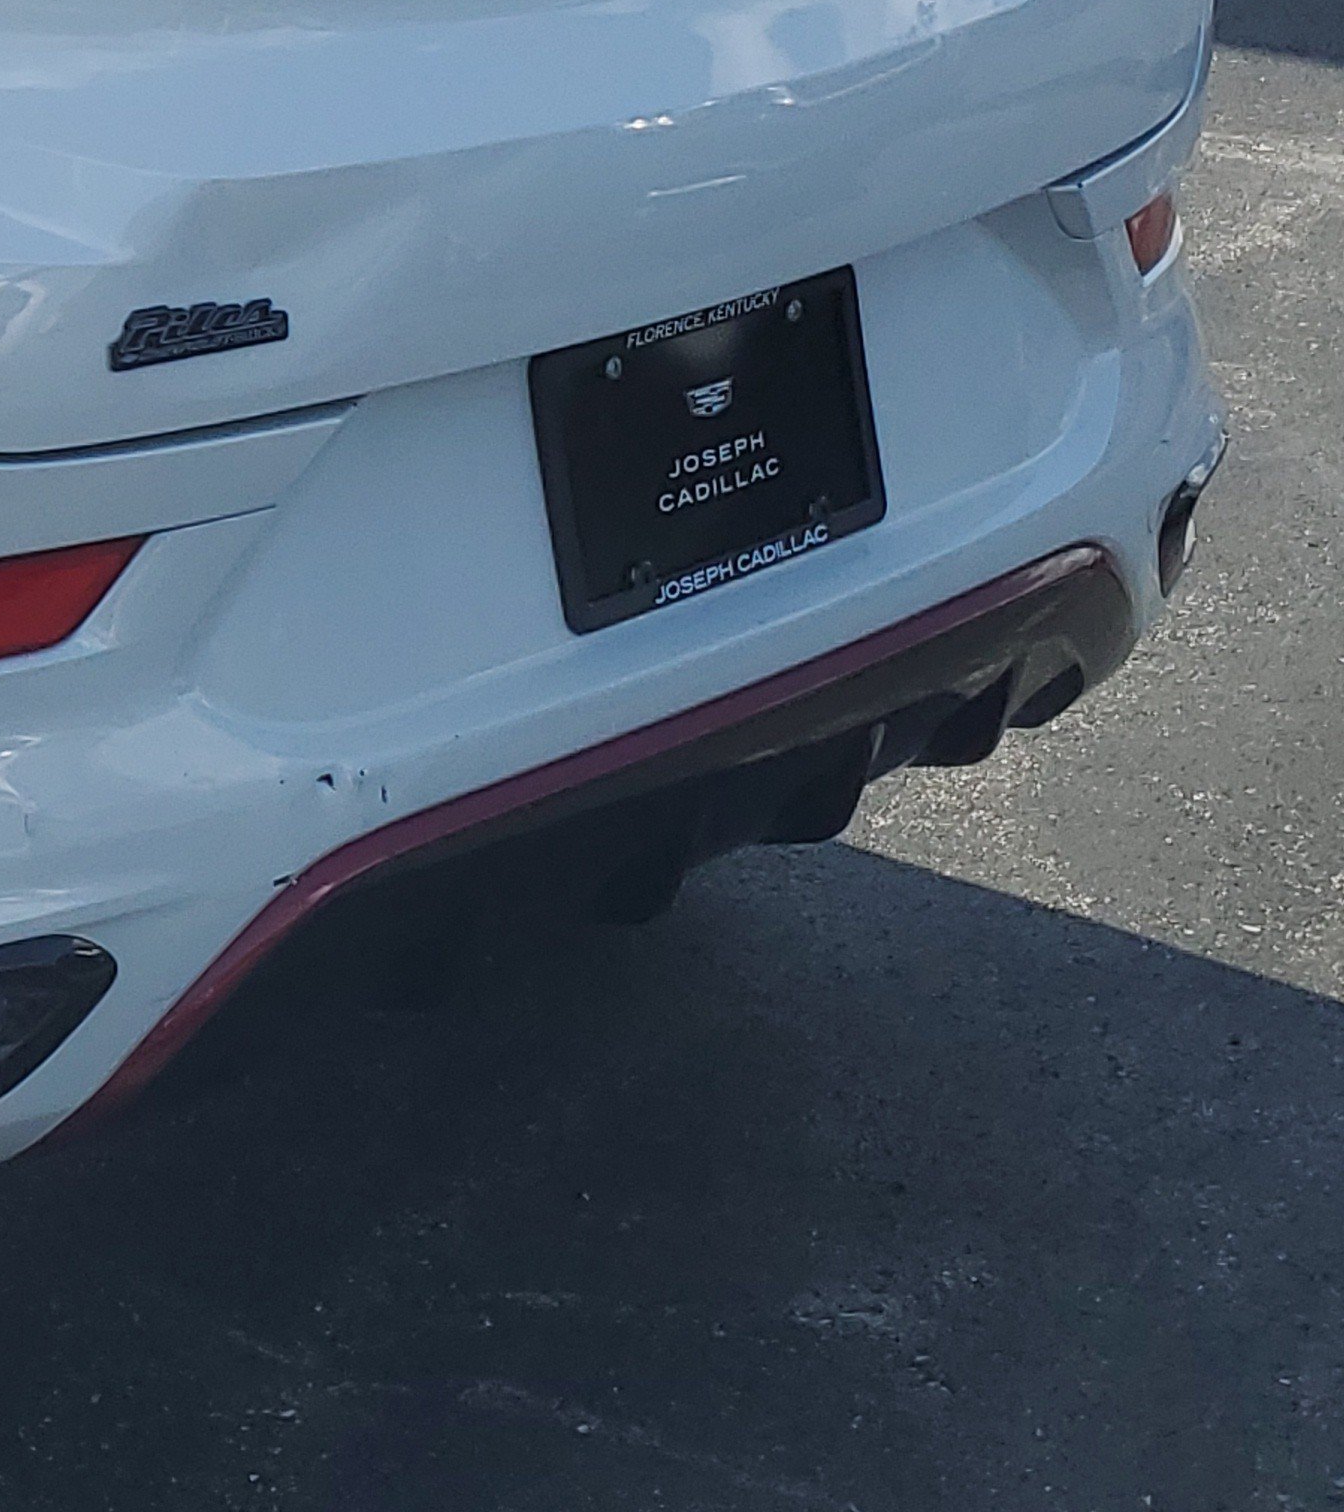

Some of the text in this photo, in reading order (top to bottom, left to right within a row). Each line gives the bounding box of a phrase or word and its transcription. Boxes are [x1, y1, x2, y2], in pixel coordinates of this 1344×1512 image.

[708, 287, 781, 323] KENTUCKY
[668, 431, 766, 479] JOSEPH
[658, 458, 780, 513] CADILLAC
[654, 525, 829, 606] JOSEPH CADILLAC
